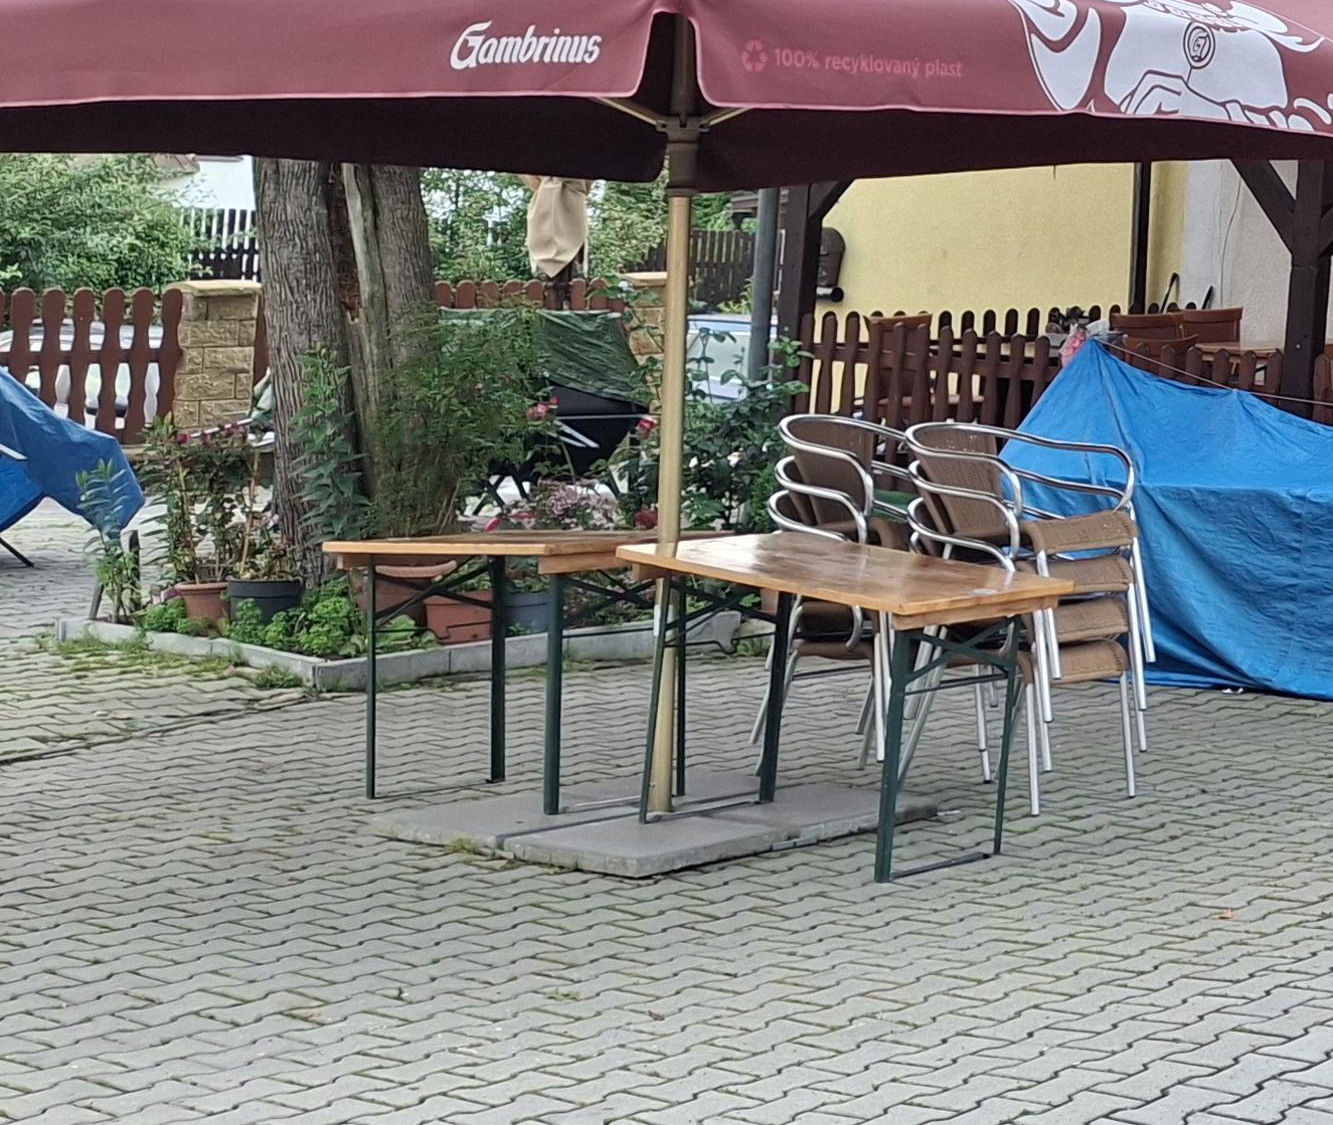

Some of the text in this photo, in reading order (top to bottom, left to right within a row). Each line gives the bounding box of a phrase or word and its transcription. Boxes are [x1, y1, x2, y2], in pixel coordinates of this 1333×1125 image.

[450, 19, 602, 70] Gambrinus
[775, 47, 964, 78] 100% recyklovaný plast
